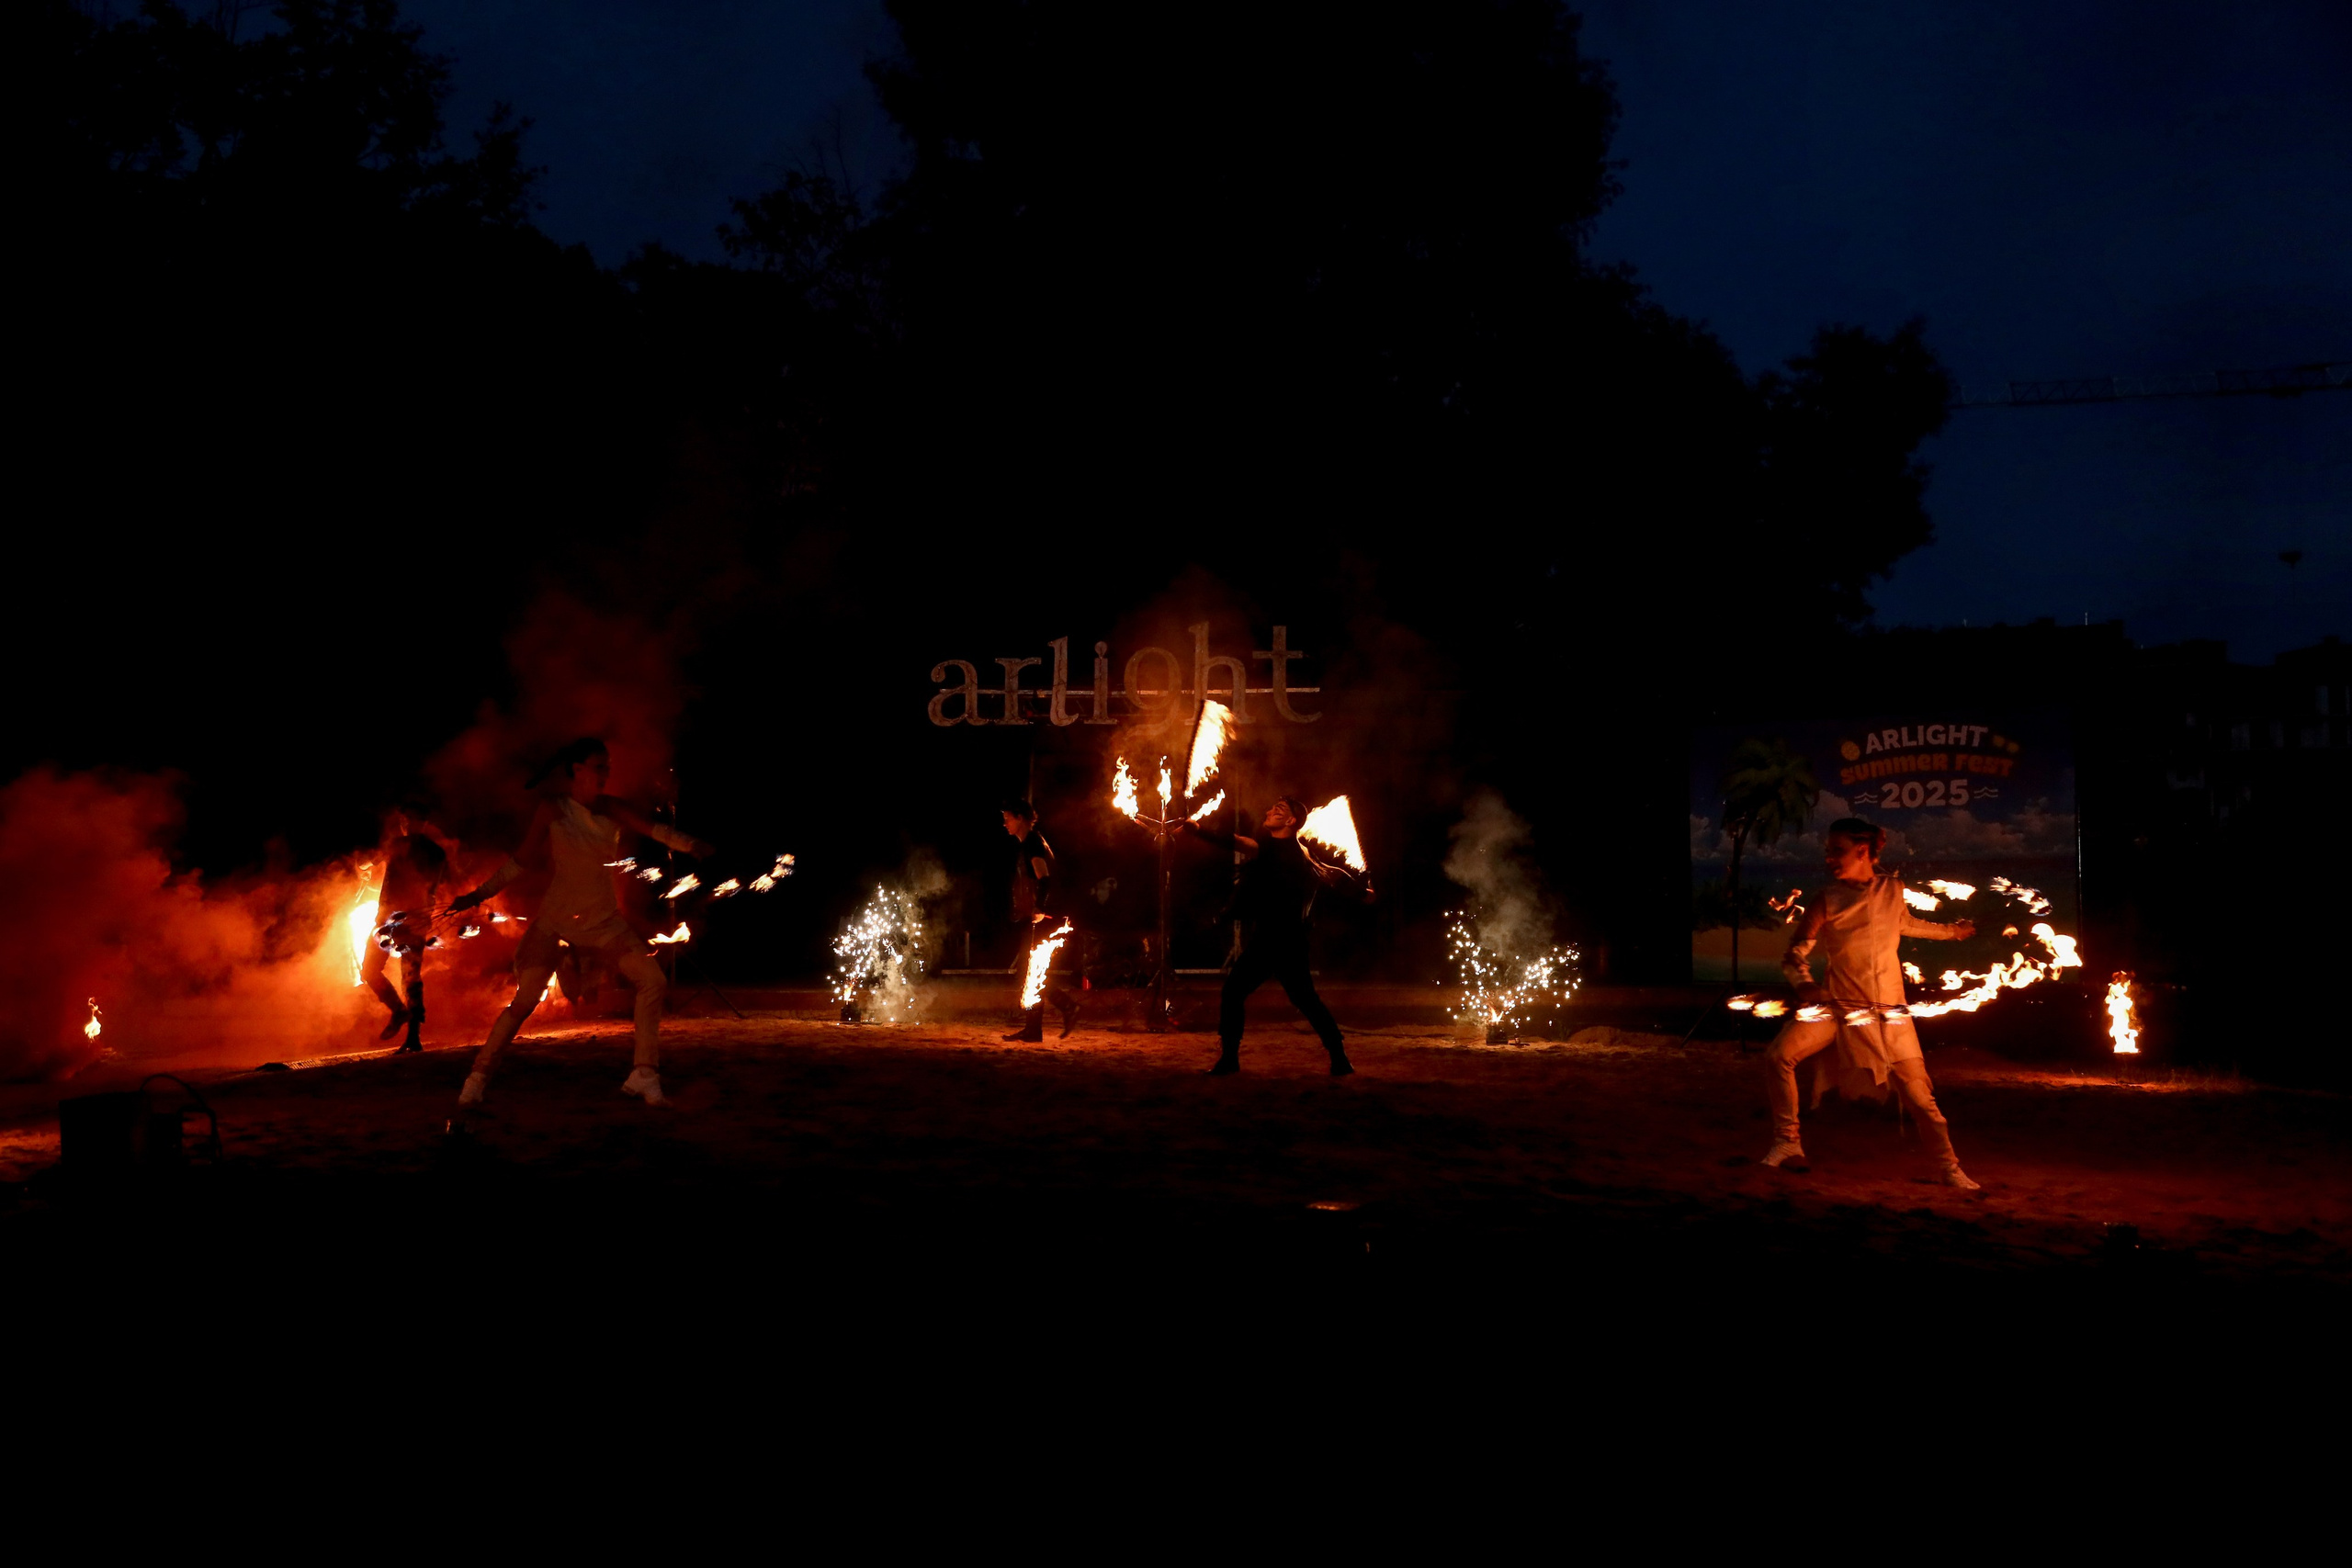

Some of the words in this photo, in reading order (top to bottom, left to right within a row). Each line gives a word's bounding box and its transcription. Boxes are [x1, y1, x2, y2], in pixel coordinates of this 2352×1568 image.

[928, 623, 1322, 739] arlight
[1866, 725, 1988, 754] ARLIGHT
[1881, 779, 1969, 808] 2025
